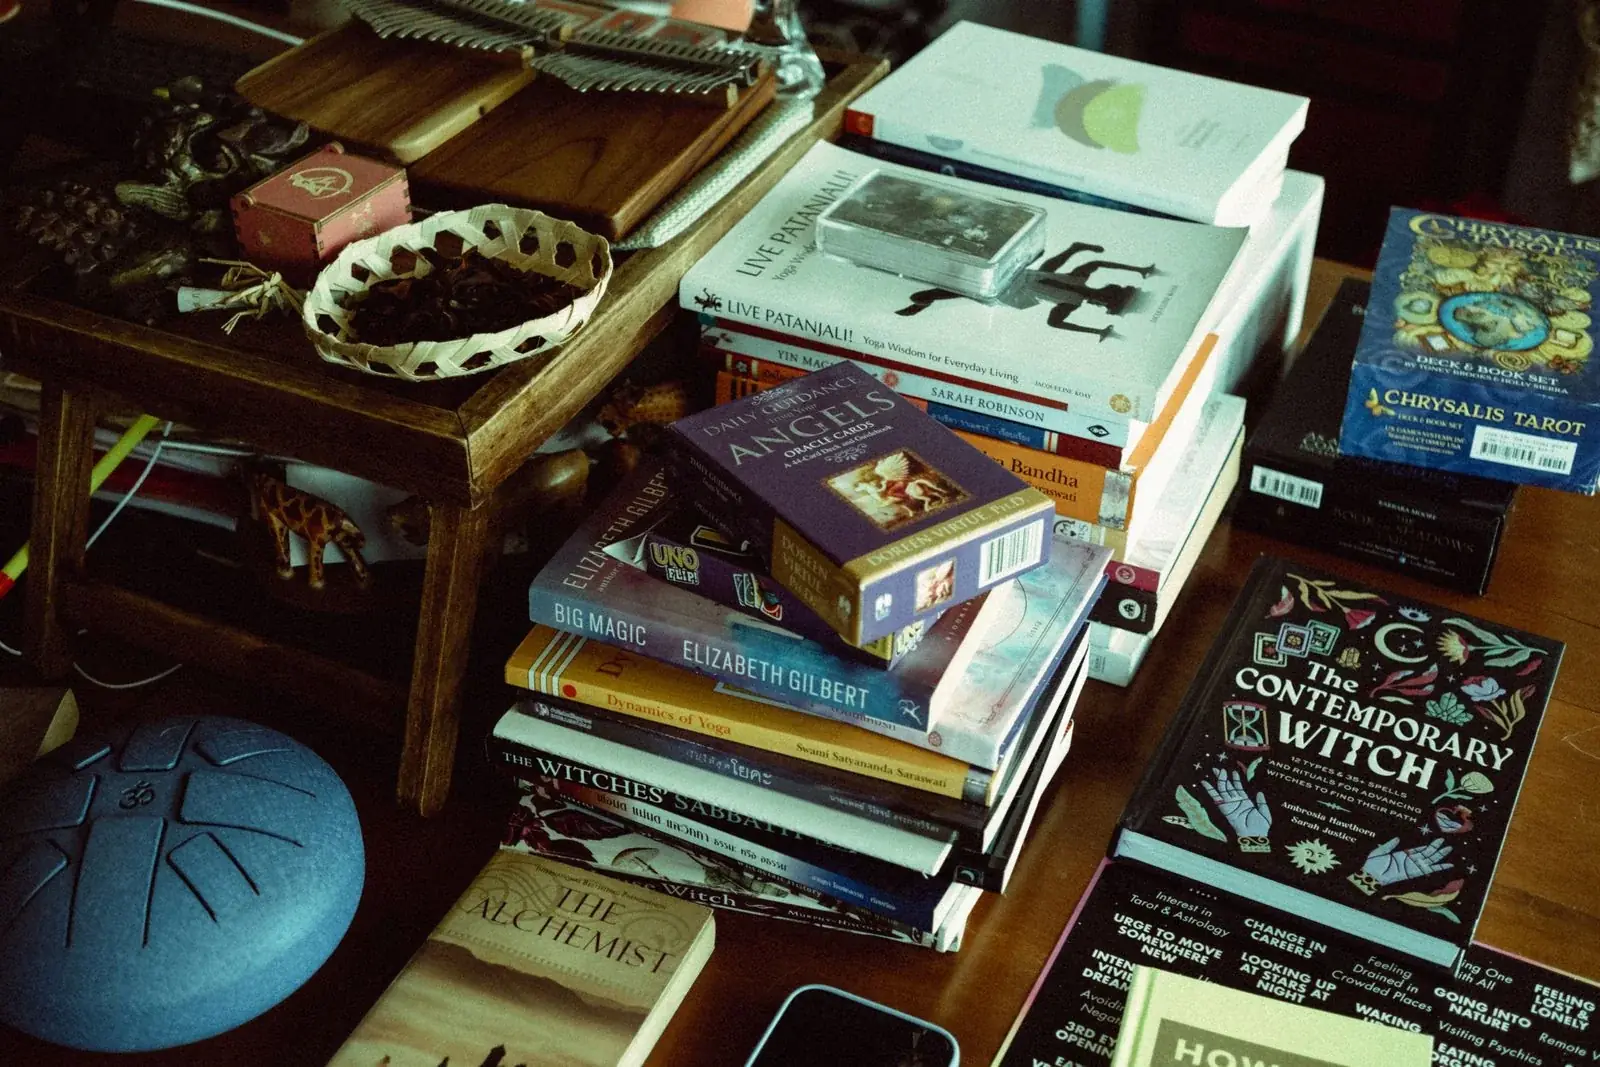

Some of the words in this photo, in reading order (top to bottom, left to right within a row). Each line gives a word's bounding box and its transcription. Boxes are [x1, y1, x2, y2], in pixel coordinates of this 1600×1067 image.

[1409, 214, 1600, 251] CHRYSALIS
[736, 244, 784, 278] LIVE
[772, 265, 797, 282] Yoga
[728, 300, 760, 321] LIVE
[765, 309, 854, 343] PATANJALI!
[863, 336, 885, 350] Yoga
[887, 342, 927, 360] Wisdom
[928, 351, 942, 364] for
[944, 356, 987, 376] Everyday
[989, 367, 1020, 384] Living
[778, 349, 798, 364] YIN
[1417, 355, 1462, 371] DECK
[1478, 363, 1525, 380] BOOK
[1529, 372, 1560, 386] SET
[703, 413, 757, 437] DAILY
[762, 376, 860, 415] GUIDANCE
[931, 386, 974, 406] SARAH
[978, 397, 1045, 423] ROBINSON
[1384, 389, 1505, 422] CHRYSALIS
[1513, 411, 1587, 437] TAROT
[728, 390, 896, 466] ANGELS
[783, 432, 833, 459] ORACLE
[834, 420, 875, 438] CARDS
[1012, 457, 1079, 489] Bandha
[650, 542, 700, 569] UNO
[867, 533, 929, 566] DOREEN
[667, 566, 699, 584] FLIP!
[554, 603, 583, 629] BIG
[589, 612, 647, 646] MAGIC
[682, 640, 783, 687] ELIZABETH
[788, 671, 870, 709] GILBERT
[1307, 660, 1360, 693] The
[1235, 666, 1515, 772] CONTEMPORARY
[607, 693, 675, 721] Dynamics
[678, 713, 693, 726] of
[698, 716, 732, 736] Yoga
[795, 743, 830, 760] Swami
[832, 751, 895, 776] Satyananda
[895, 766, 948, 790] Saraswati
[1278, 710, 1439, 790] WITCH
[502, 751, 533, 768] THE
[729, 759, 773, 786] โยคะ
[1267, 758, 1293, 774] AND
[1292, 766, 1336, 787] RITUALS
[1338, 780, 1360, 796] FOR
[1361, 788, 1422, 815] ADVANCING
[1302, 758, 1336, 775] TYPES
[1335, 768, 1344, 778] &
[1345, 771, 1367, 784] 35+
[1368, 779, 1407, 799] SPELLS
[1266, 768, 1314, 792] WITCHES
[1314, 783, 1329, 796] TO
[1329, 788, 1356, 803] FIND
[1357, 796, 1389, 814] THEIR
[1386, 807, 1419, 824] PATH
[1280, 800, 1327, 824] Ambrosia
[1329, 815, 1376, 839] Hawthorn
[1291, 815, 1320, 833] Sarah
[1321, 825, 1358, 844] Justice
[555, 887, 627, 926] THE
[662, 882, 737, 908] Witch
[1155, 891, 1199, 914] Interest
[1201, 907, 1213, 918] in
[1129, 893, 1160, 912] Tarot
[1160, 904, 1171, 916] &
[1173, 909, 1231, 938] Astrology
[466, 897, 677, 974] ALCHEMIST
[1113, 912, 1153, 934] URGE
[1155, 926, 1175, 940] TO
[1179, 936, 1224, 960] MOVE
[1118, 925, 1210, 966] SOMEWHERE
[1244, 918, 1305, 950] CHANGE
[1309, 938, 1328, 954] IN
[1250, 930, 1314, 960] CAREERS
[1140, 944, 1178, 965] NEW
[1367, 955, 1413, 980] Feeling
[1239, 962, 1260, 977] AT
[1261, 970, 1308, 994] STARS
[1310, 988, 1331, 1002] AT
[1240, 951, 1313, 985] LOOKING
[1315, 978, 1338, 993] UP
[1352, 963, 1406, 989] Drained
[1407, 982, 1419, 994] in
[1475, 977, 1496, 991] All
[1485, 967, 1514, 984] One
[1256, 979, 1306, 1004] NIGHT
[1331, 969, 1391, 999] Crowded
[1392, 991, 1434, 1013] Places
[1433, 986, 1489, 1013] GOING
[1492, 1007, 1532, 1029] INTO
[1534, 983, 1596, 1013] FEELING
[1354, 1002, 1422, 1034] WAKING
[1448, 1003, 1511, 1033] NATURE
[1530, 1005, 1590, 1032] LONELY
[1534, 994, 1575, 1016] LOST
[1576, 1009, 1590, 1022] &
[1064, 1020, 1096, 1039] 3RD
[1438, 1020, 1485, 1047] Visiting
[1488, 1038, 1543, 1066] Psychics
[1538, 1032, 1588, 1057] Remote
[1437, 1042, 1496, 1067] EATING
